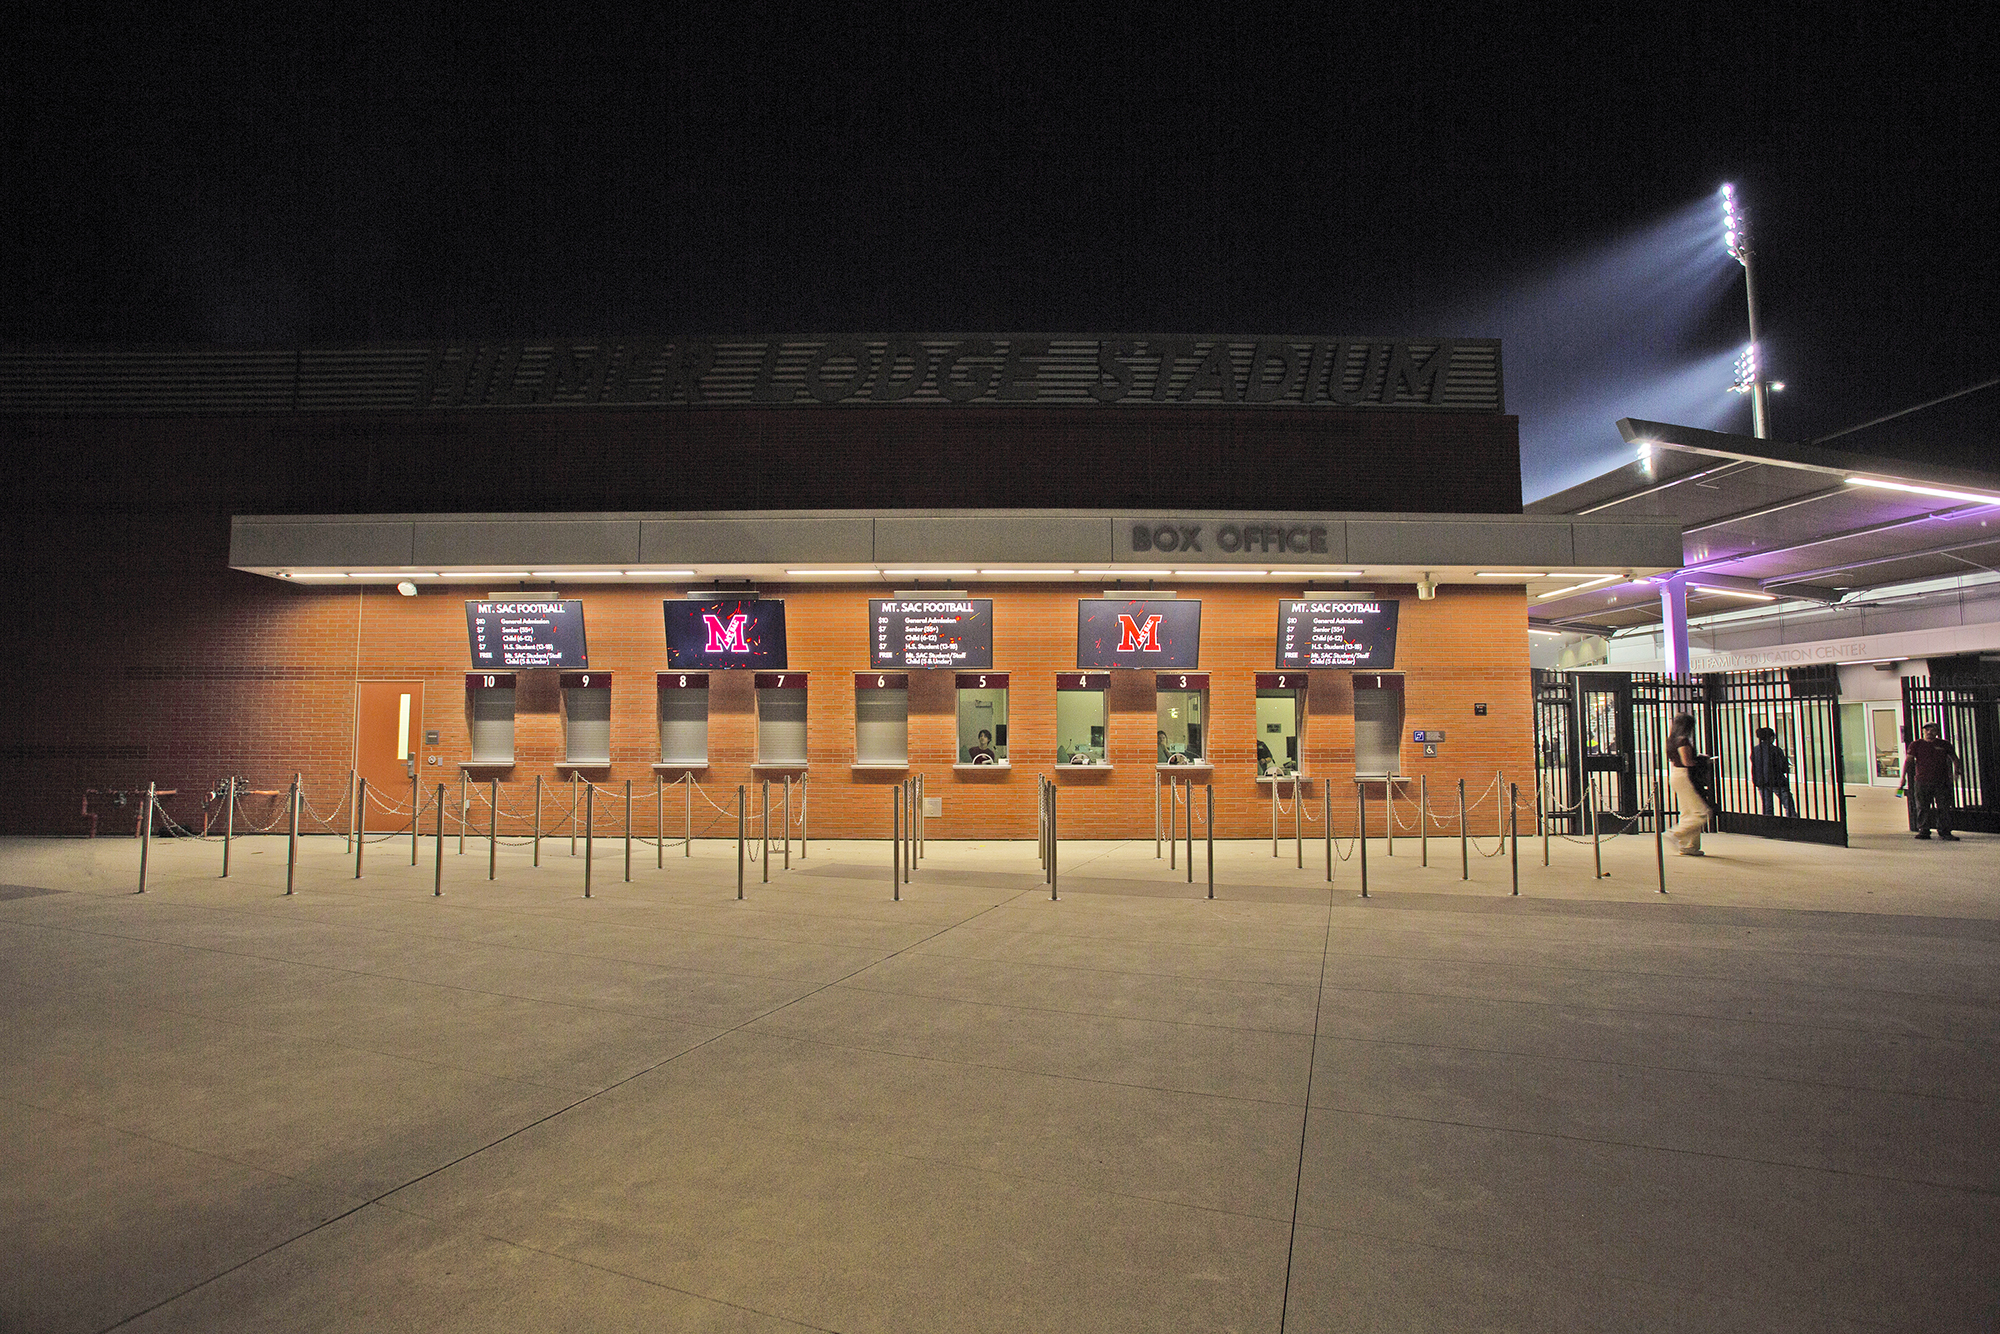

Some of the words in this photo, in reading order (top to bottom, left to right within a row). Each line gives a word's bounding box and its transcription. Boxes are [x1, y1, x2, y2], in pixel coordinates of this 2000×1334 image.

[748, 340, 1050, 403] LODGE
[1085, 340, 1453, 404] STADIUM
[1132, 524, 1202, 552] BOX
[1216, 524, 1328, 554] OFFICE
[478, 604, 495, 613] MT.
[496, 604, 516, 613] SAC
[517, 604, 565, 613] FOOTBALL
[882, 603, 899, 612] MT.
[901, 603, 922, 612] SAC
[923, 603, 974, 612] FOOTBALL
[1292, 603, 1309, 612] MT.
[1311, 603, 1331, 612] SAC
[1332, 603, 1381, 613] FOOTBALL
[702, 614, 750, 652] M
[1116, 614, 1162, 652] M
[1706, 656, 1740, 669] FAMILY
[1744, 648, 1812, 665] EDUCATION
[1816, 642, 1867, 659] CENTER
[483, 675, 495, 688] 10
[582, 675, 590, 687] 9
[680, 675, 687, 687] 8
[777, 675, 785, 687] 7
[878, 675, 885, 687] 6
[979, 675, 986, 687] 5
[1079, 676, 1086, 687] 4
[1180, 676, 1187, 688] 3
[1278, 676, 1286, 688] 2
[1376, 676, 1382, 688] 1
